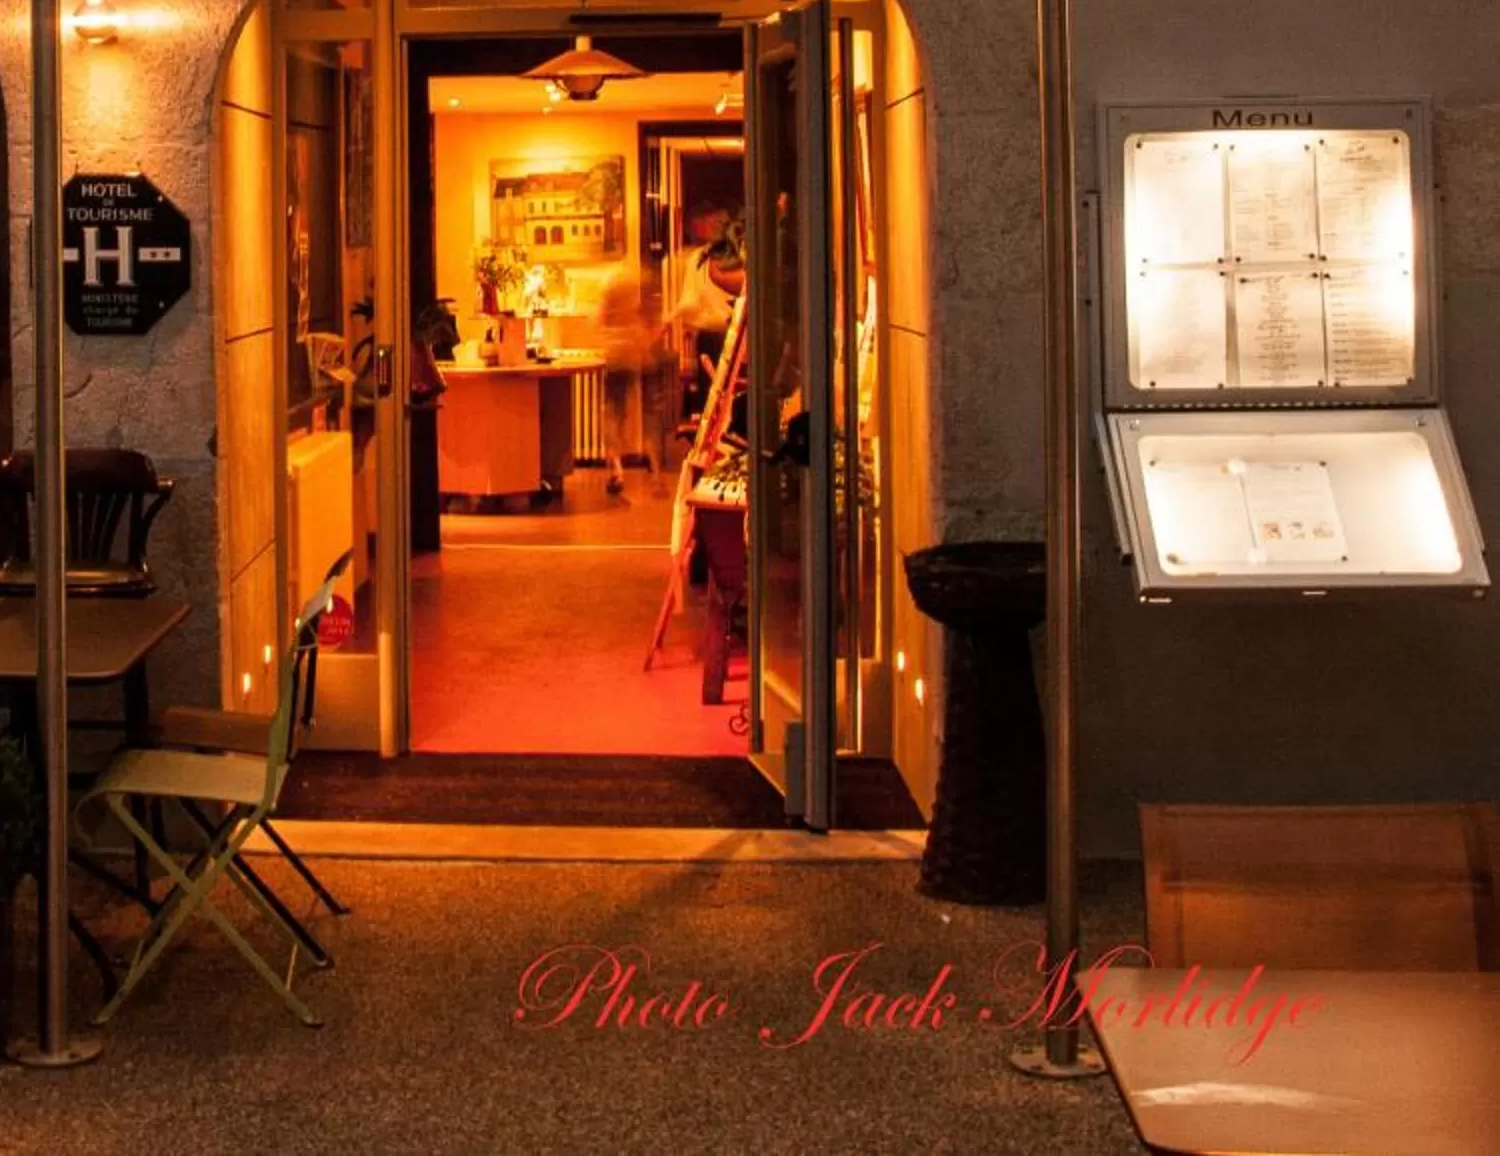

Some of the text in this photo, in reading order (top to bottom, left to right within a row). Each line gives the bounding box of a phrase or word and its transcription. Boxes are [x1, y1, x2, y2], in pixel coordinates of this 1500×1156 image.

[1211, 108, 1313, 128] Menu
[67, 207, 154, 221] TOURISME
[82, 226, 135, 286] H
